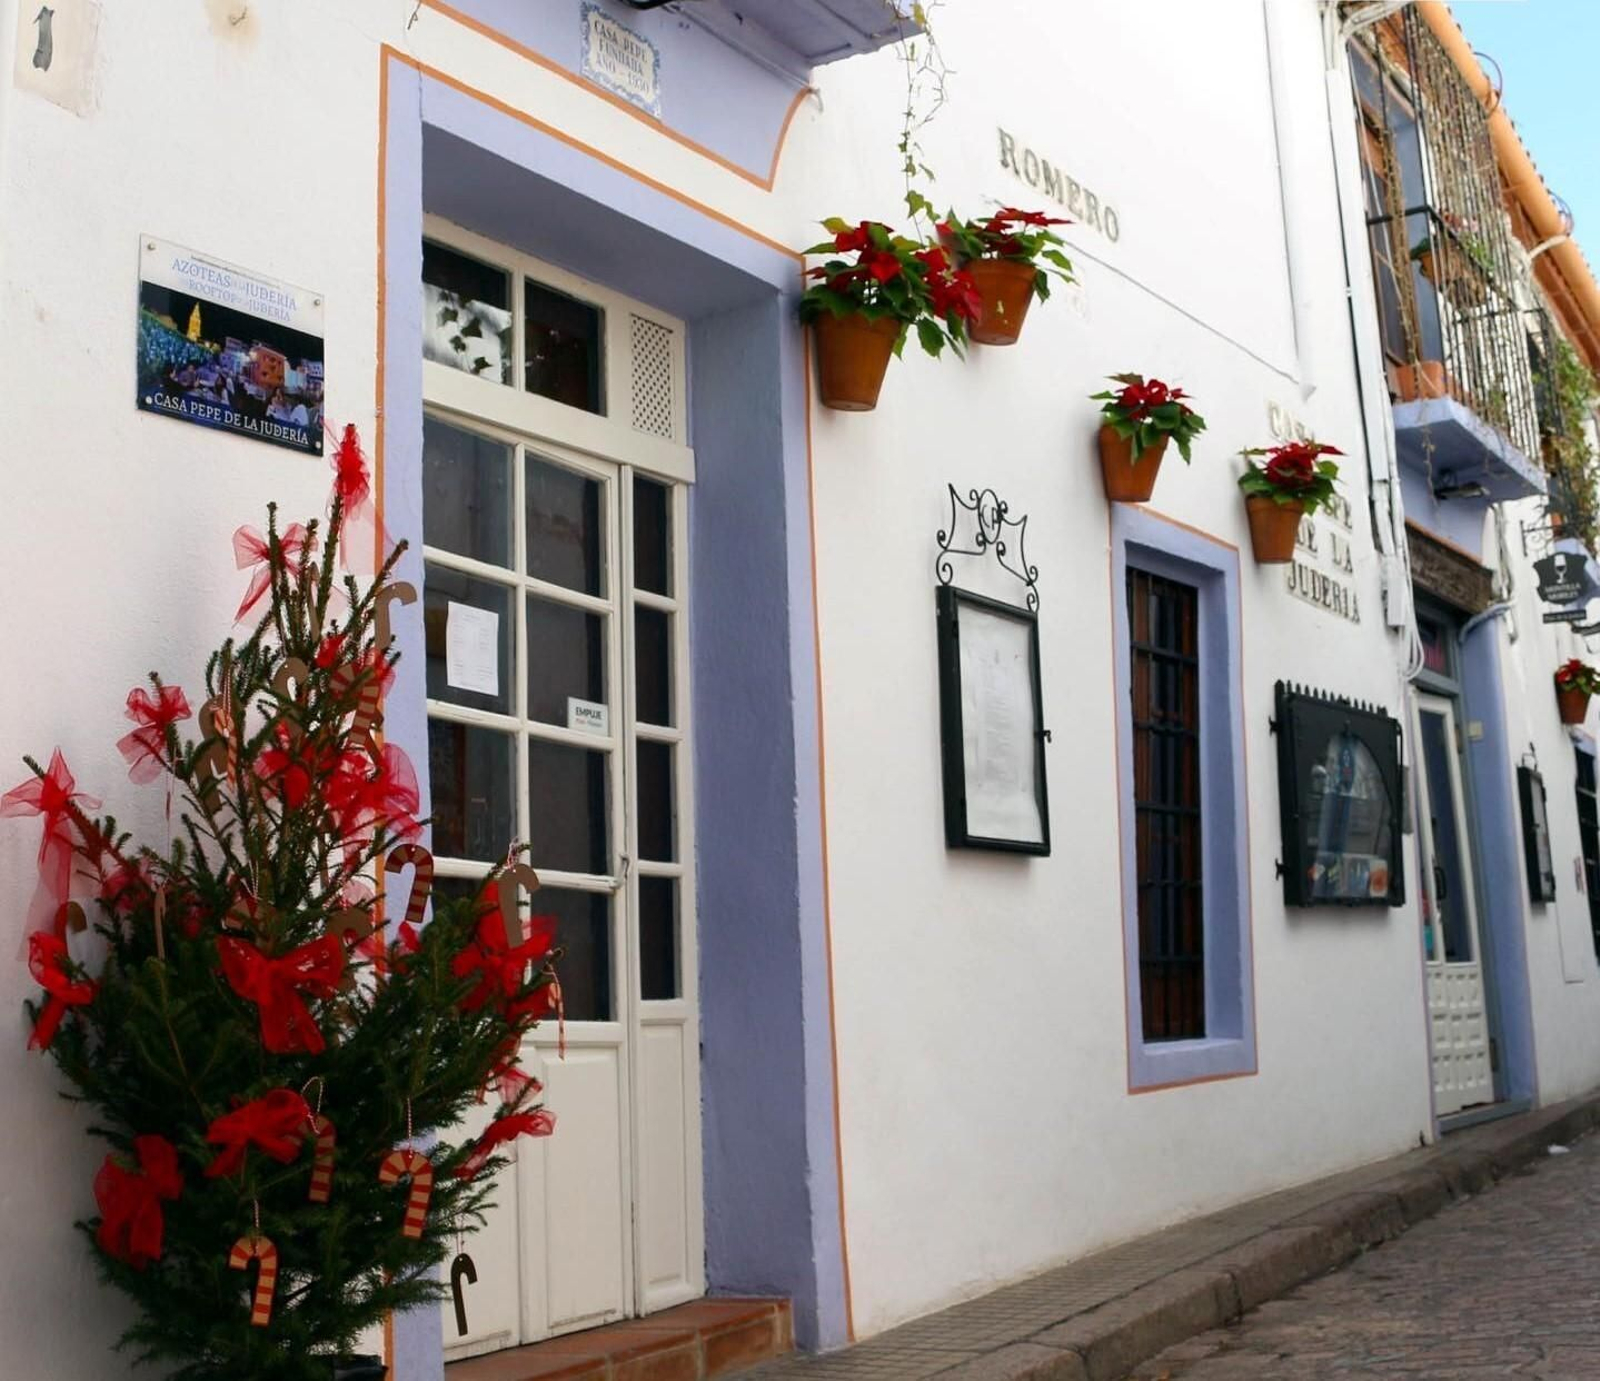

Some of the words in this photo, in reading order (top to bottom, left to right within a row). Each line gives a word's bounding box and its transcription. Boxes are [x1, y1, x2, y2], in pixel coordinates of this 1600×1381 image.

[594, 20, 618, 44] CASA
[624, 38, 648, 63] PEPE
[998, 127, 1120, 243] ROMERO
[171, 258, 231, 289] AZOTEAS
[188, 279, 236, 303] ROOFTOP
[153, 392, 188, 412] CASA
[190, 401, 222, 421] PEPE
[224, 410, 242, 426] DE
[244, 415, 258, 431] LA
[258, 419, 309, 445] JUDERÍA
[1330, 531, 1353, 574] LA
[1287, 558, 1360, 624] JUDERIA
[575, 706, 602, 720] EMPUJE
